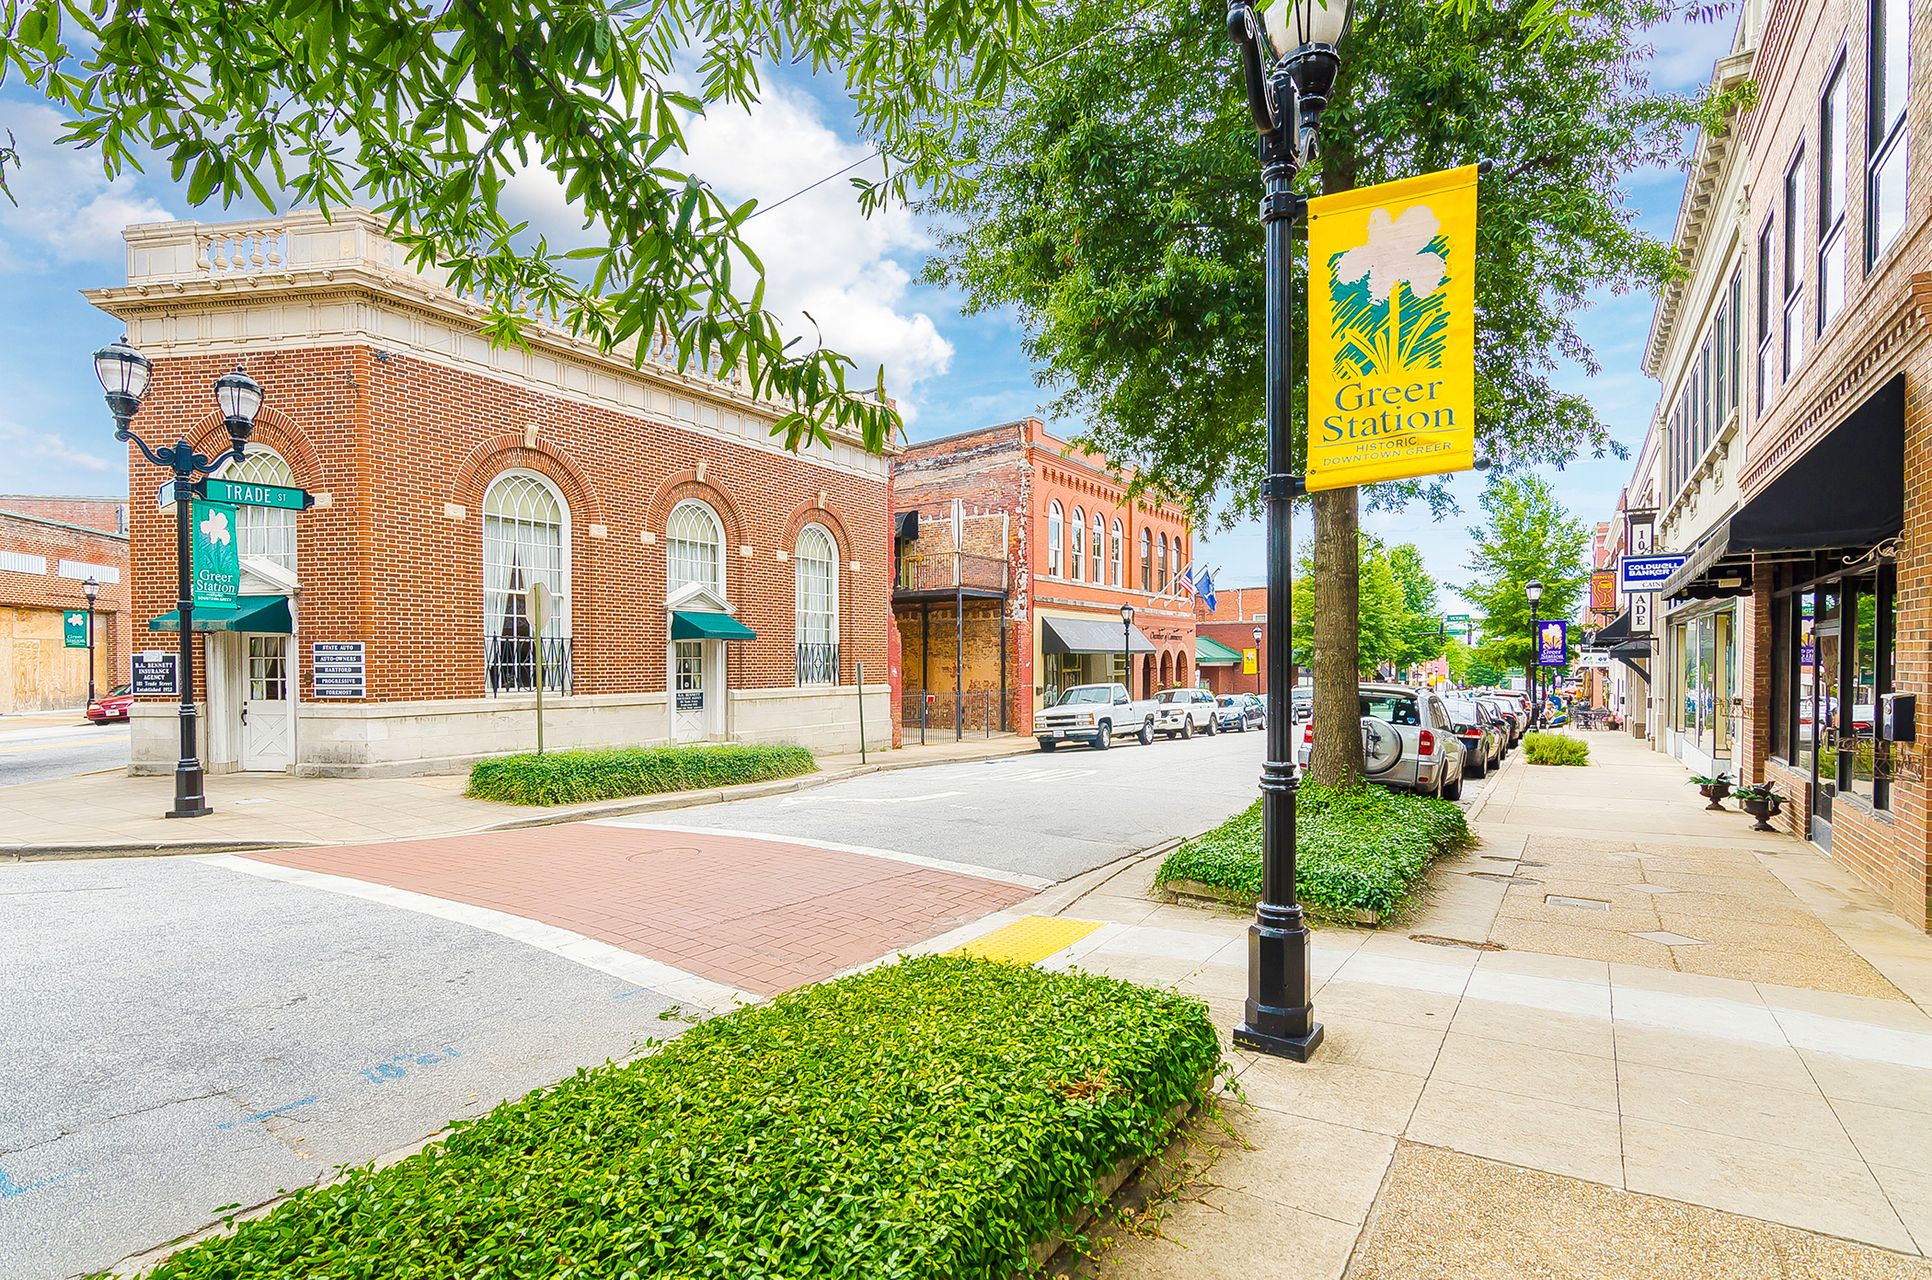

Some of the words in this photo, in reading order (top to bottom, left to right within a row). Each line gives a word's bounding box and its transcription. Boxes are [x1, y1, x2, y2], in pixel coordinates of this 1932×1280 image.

[1335, 381, 1443, 412] Greer
[1323, 406, 1455, 442] Station
[1356, 437, 1417, 452] HISTORIC
[1323, 450, 1402, 466] DOWNTOWN
[1406, 442, 1452, 456] GREER
[225, 484, 272, 504] TRADE
[277, 493, 287, 502] ST
[1628, 562, 1680, 571] COLDWELL
[1628, 569, 1670, 577] BANKER
[199, 569, 233, 583] Greer
[196, 579, 235, 593] Station
